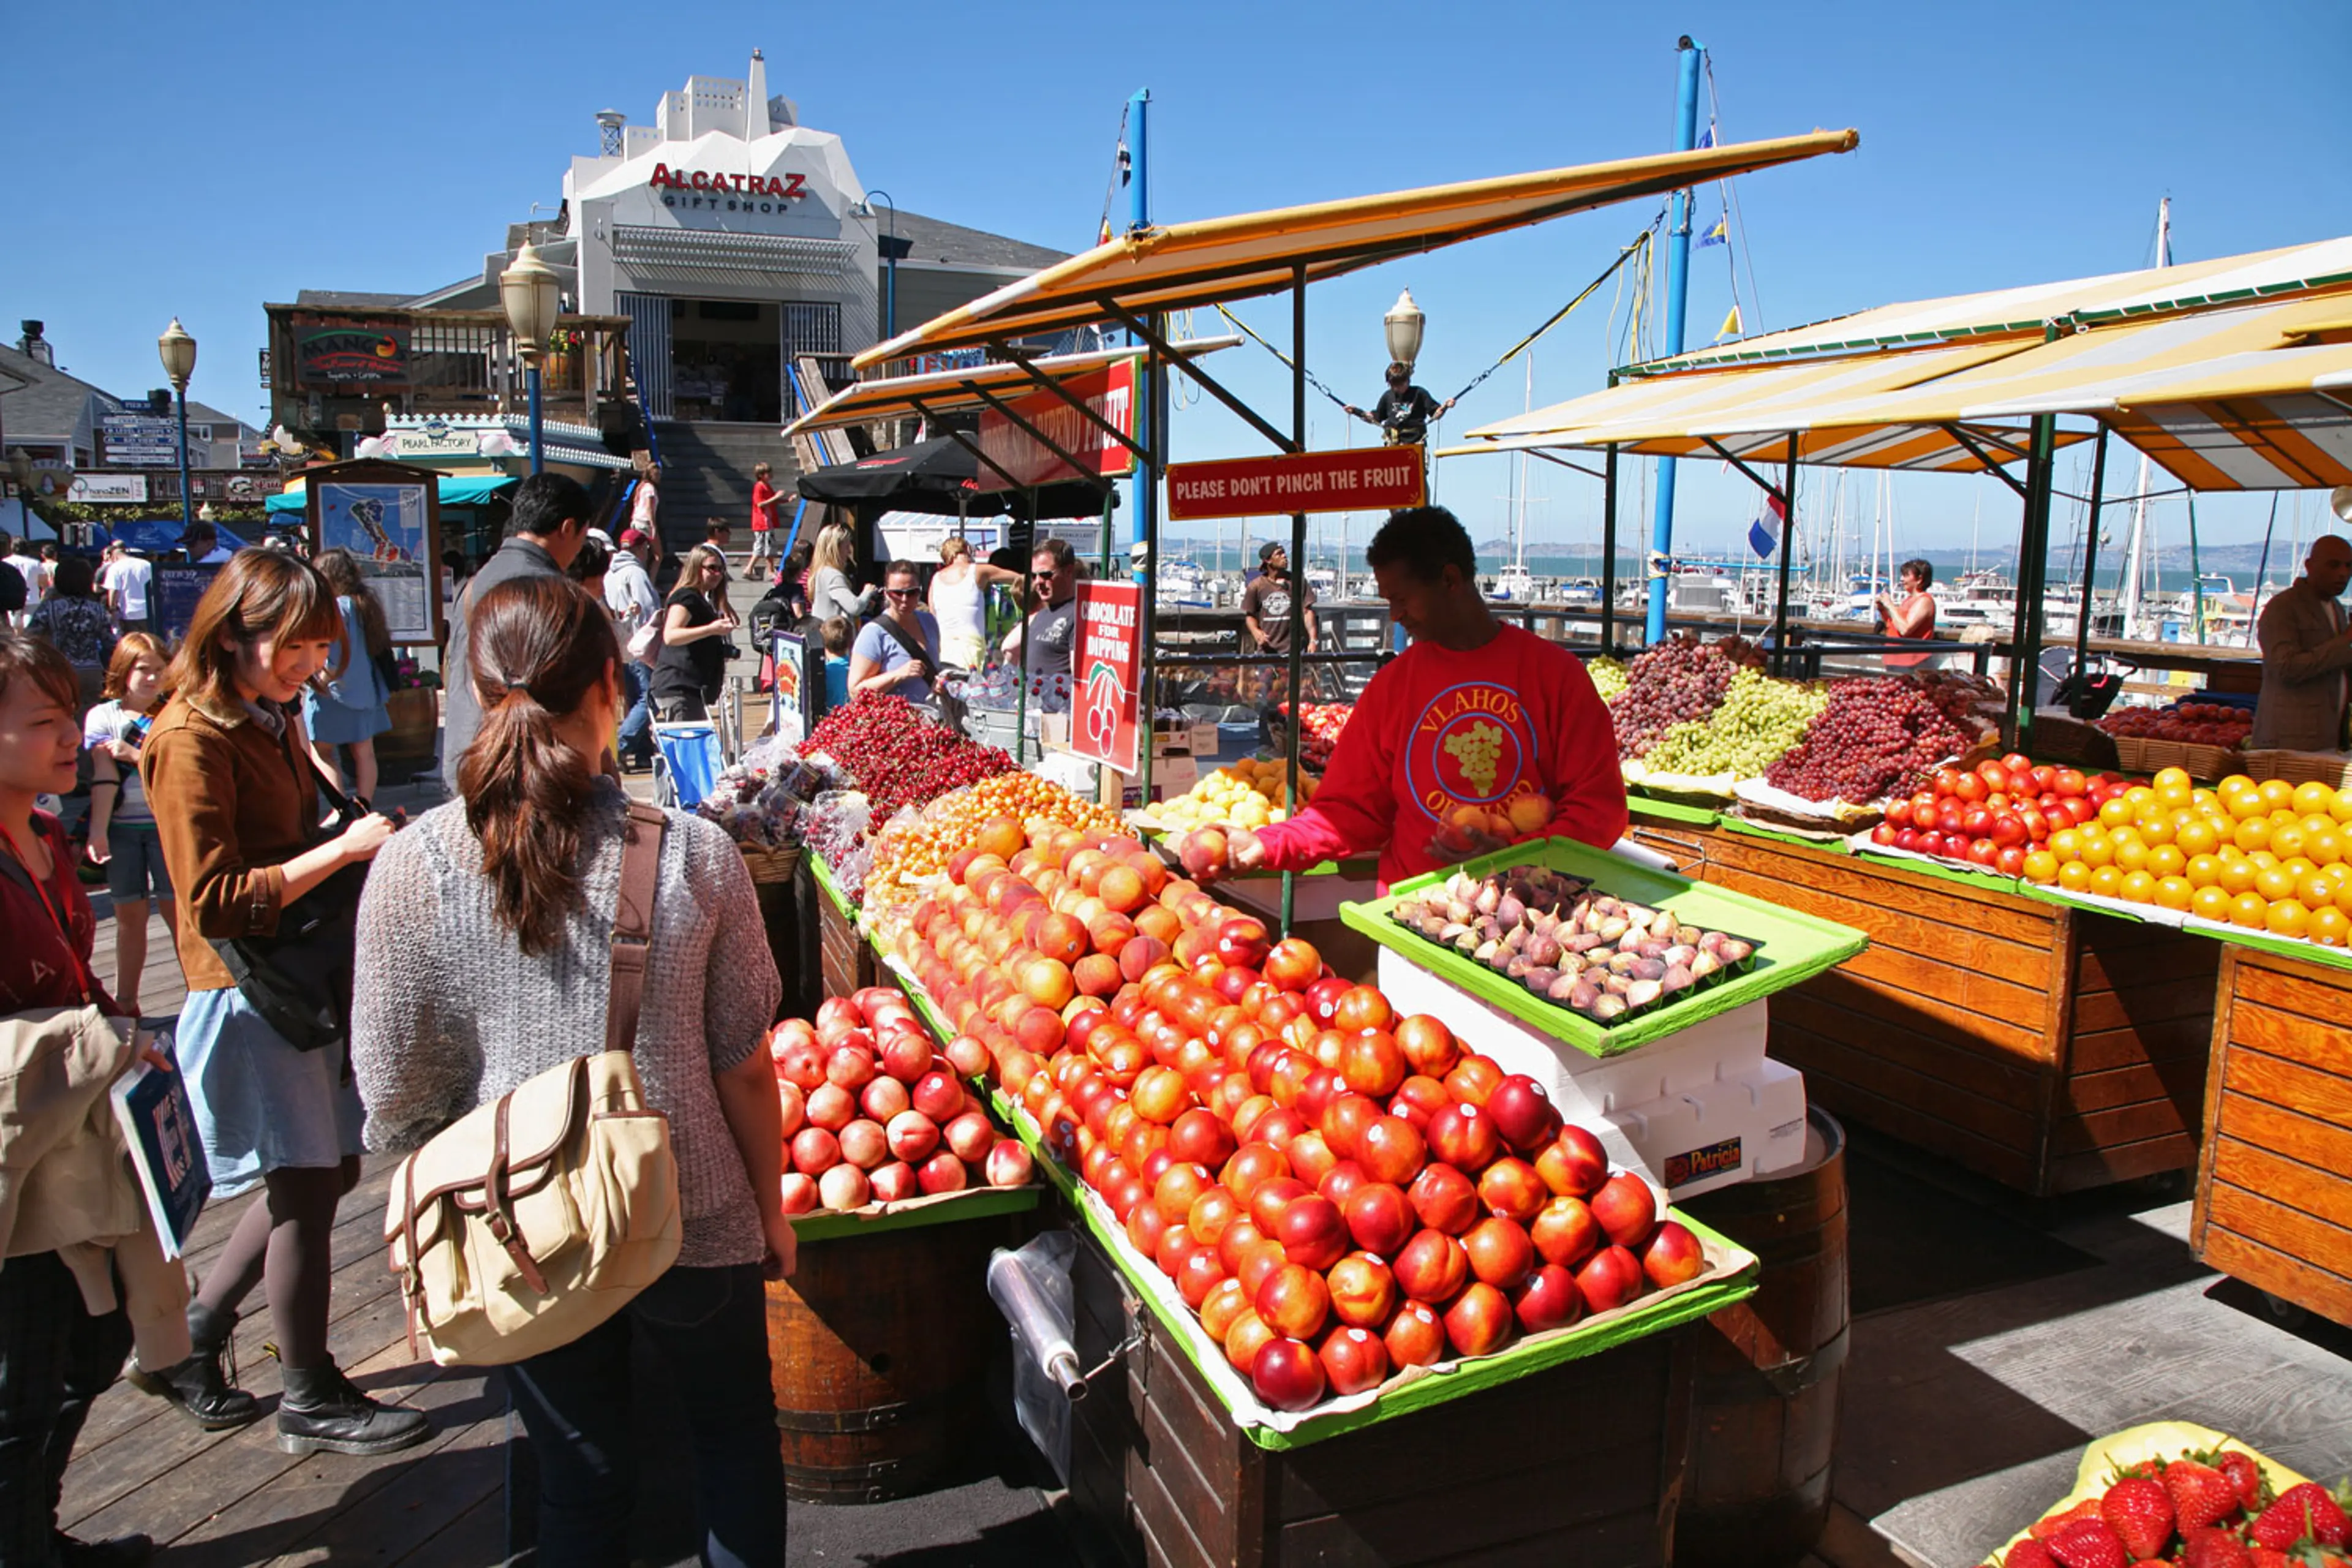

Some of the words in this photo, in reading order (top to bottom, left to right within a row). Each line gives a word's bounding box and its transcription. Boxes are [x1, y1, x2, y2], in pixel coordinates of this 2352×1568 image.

[650, 163, 806, 197] ALCATRAZ
[665, 196, 717, 210] GIFT
[728, 200, 787, 214] SHOP
[1084, 386, 1129, 453] FRUIT
[402, 439, 429, 448] PEARL
[431, 438, 471, 448] FACTORY
[1176, 480, 1225, 500] PLEASE
[1231, 476, 1272, 497] DON'T
[1276, 472, 1324, 494] PINCH
[1329, 470, 1358, 490] THE
[1363, 466, 1411, 488] FRUIT
[1082, 601, 1136, 627] CHOCOLATE
[1098, 625, 1120, 639] FOR
[1087, 635, 1129, 663] DIPPING
[1420, 689, 1521, 732] VLAHOS
[1426, 780, 1534, 817] ORAD
[1691, 1145, 1740, 1174] Patricia
